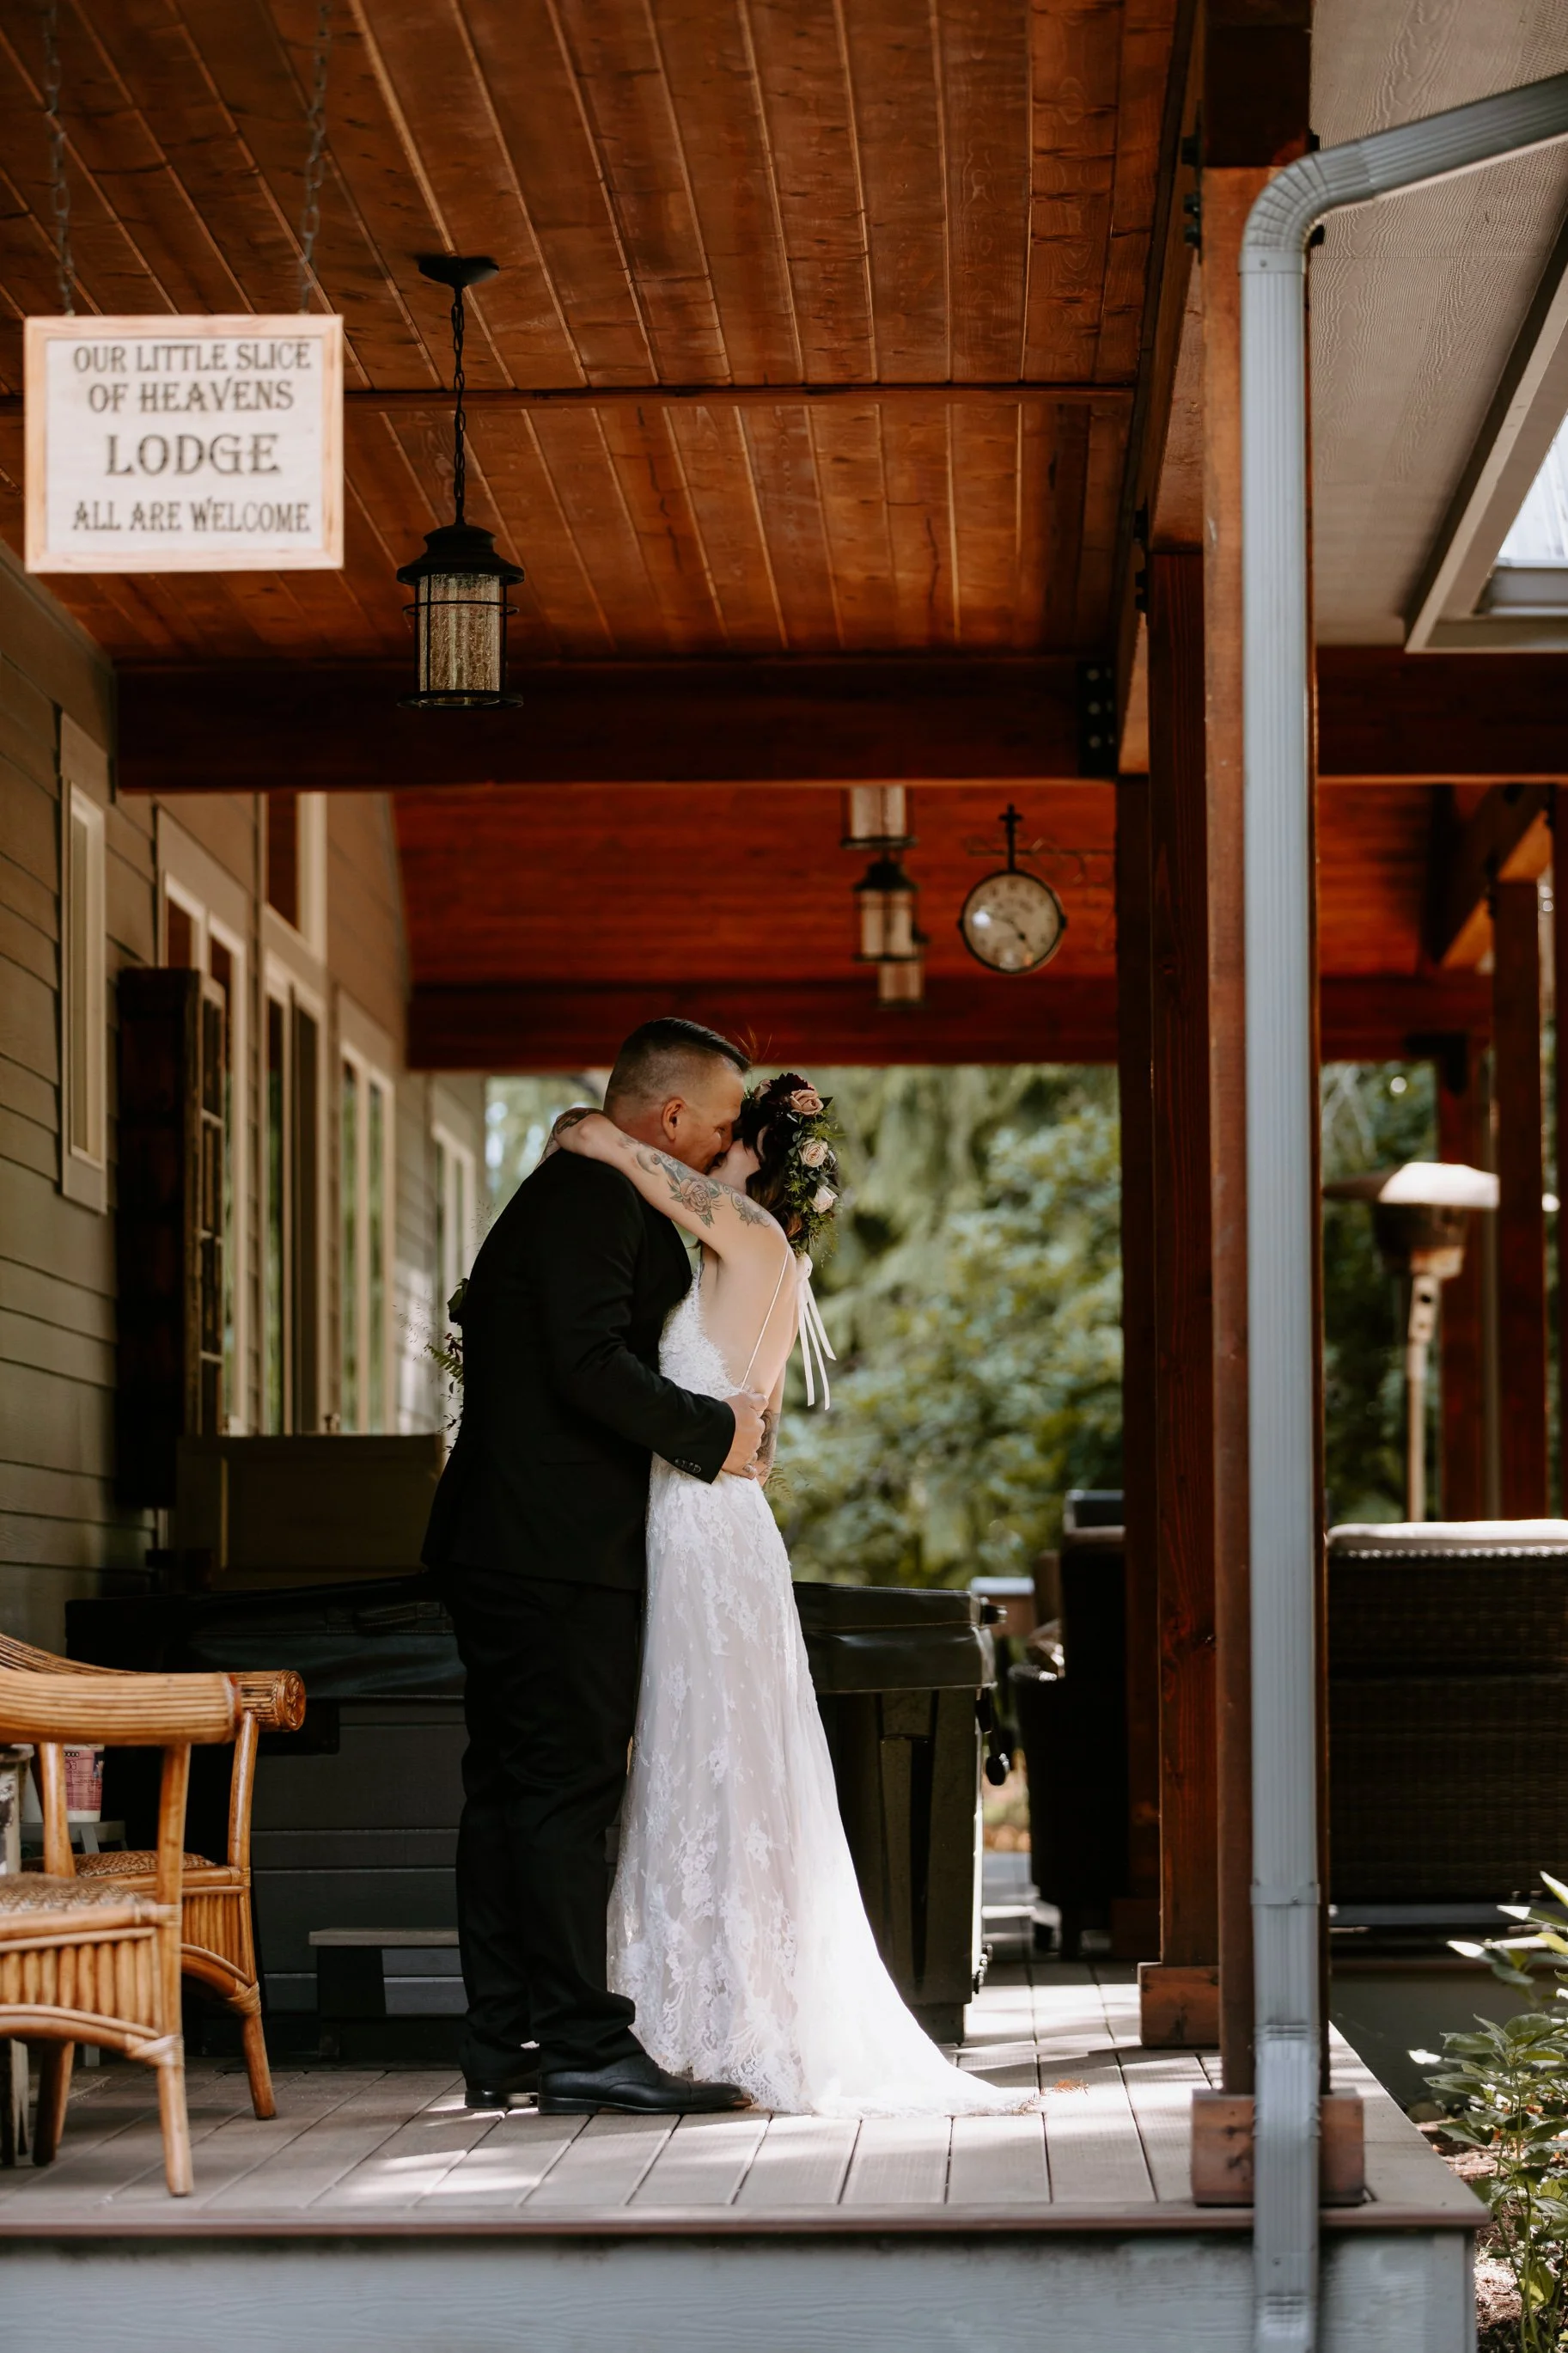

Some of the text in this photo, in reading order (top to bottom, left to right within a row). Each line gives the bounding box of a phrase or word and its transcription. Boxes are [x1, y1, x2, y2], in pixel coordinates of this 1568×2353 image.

[72, 340, 312, 373] OUR LITTLE SLICE
[88, 376, 295, 413] OF HEAVENS
[105, 433, 281, 477] LODGE
[71, 496, 312, 533] ALL ARE WELCOME
